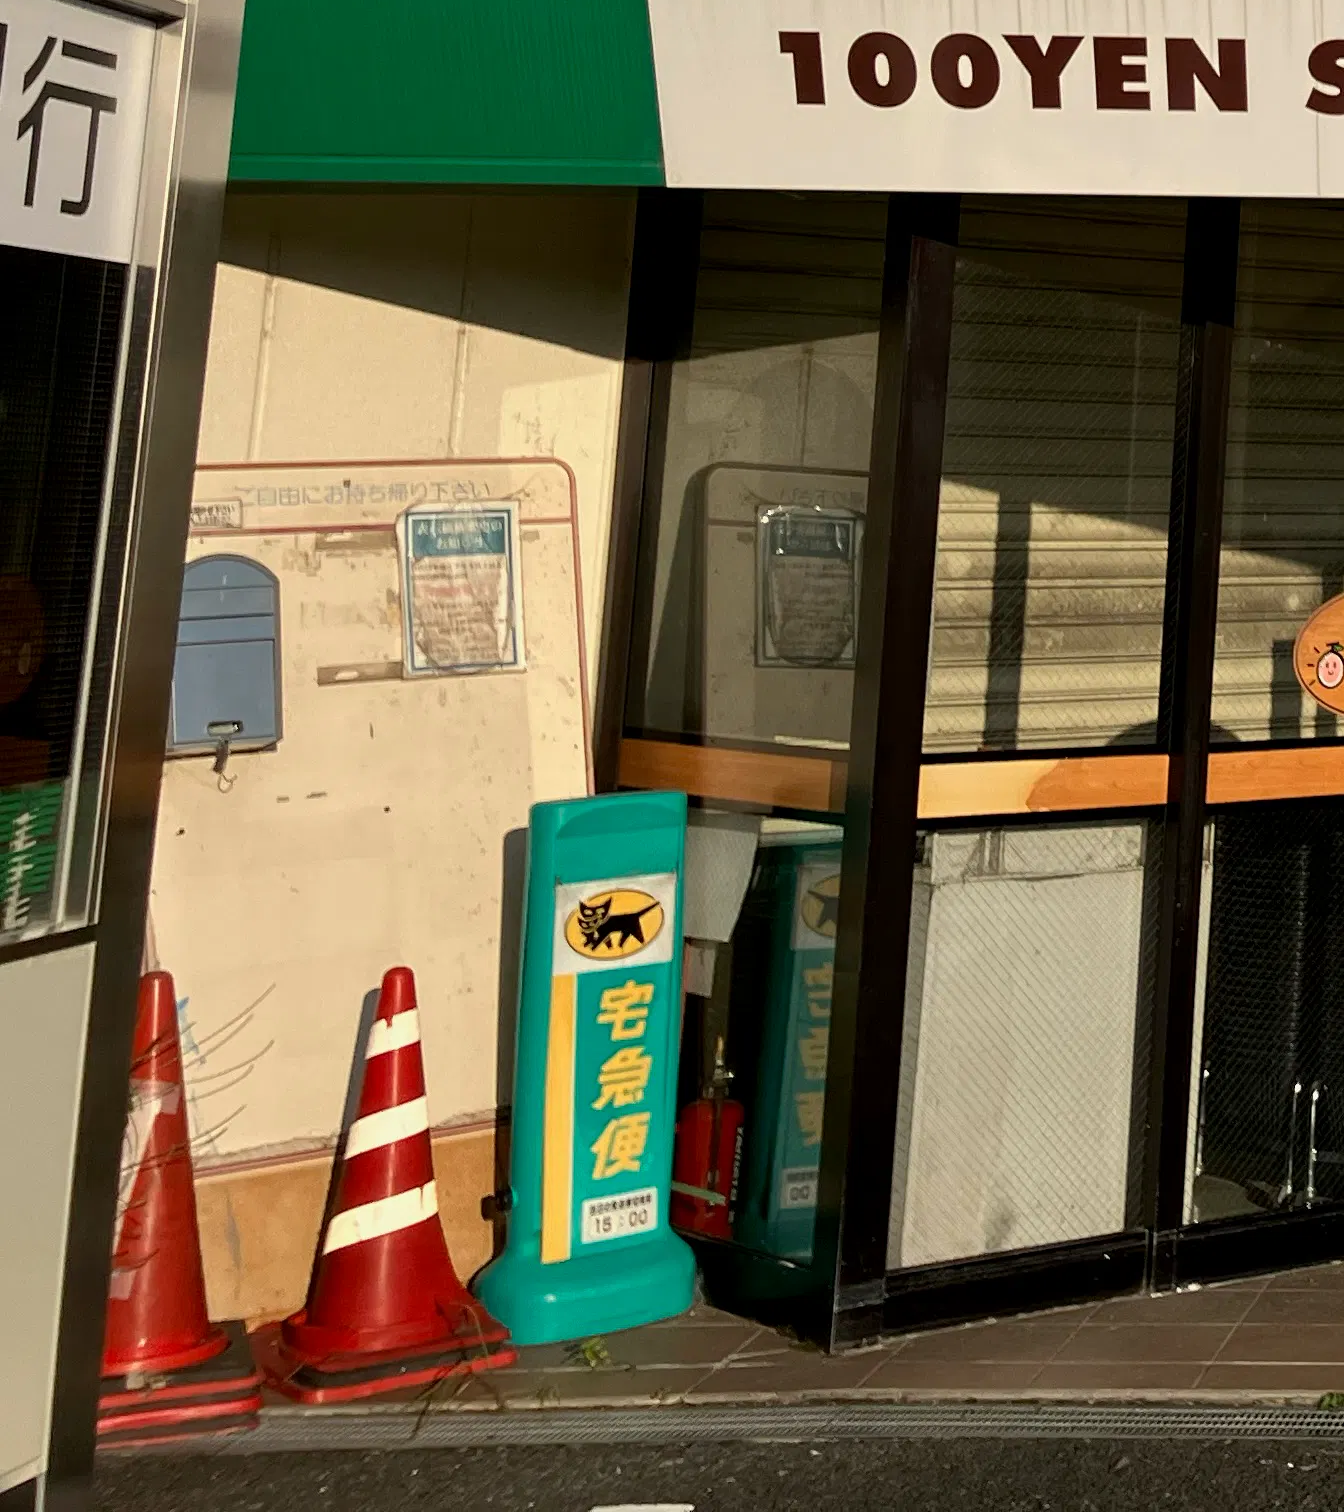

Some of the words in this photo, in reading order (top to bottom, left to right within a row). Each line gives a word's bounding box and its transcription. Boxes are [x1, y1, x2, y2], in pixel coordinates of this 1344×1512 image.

[0, 22, 118, 216] 行
[778, 31, 1249, 112] 100YEN
[589, 979, 655, 1181] 宅急便
